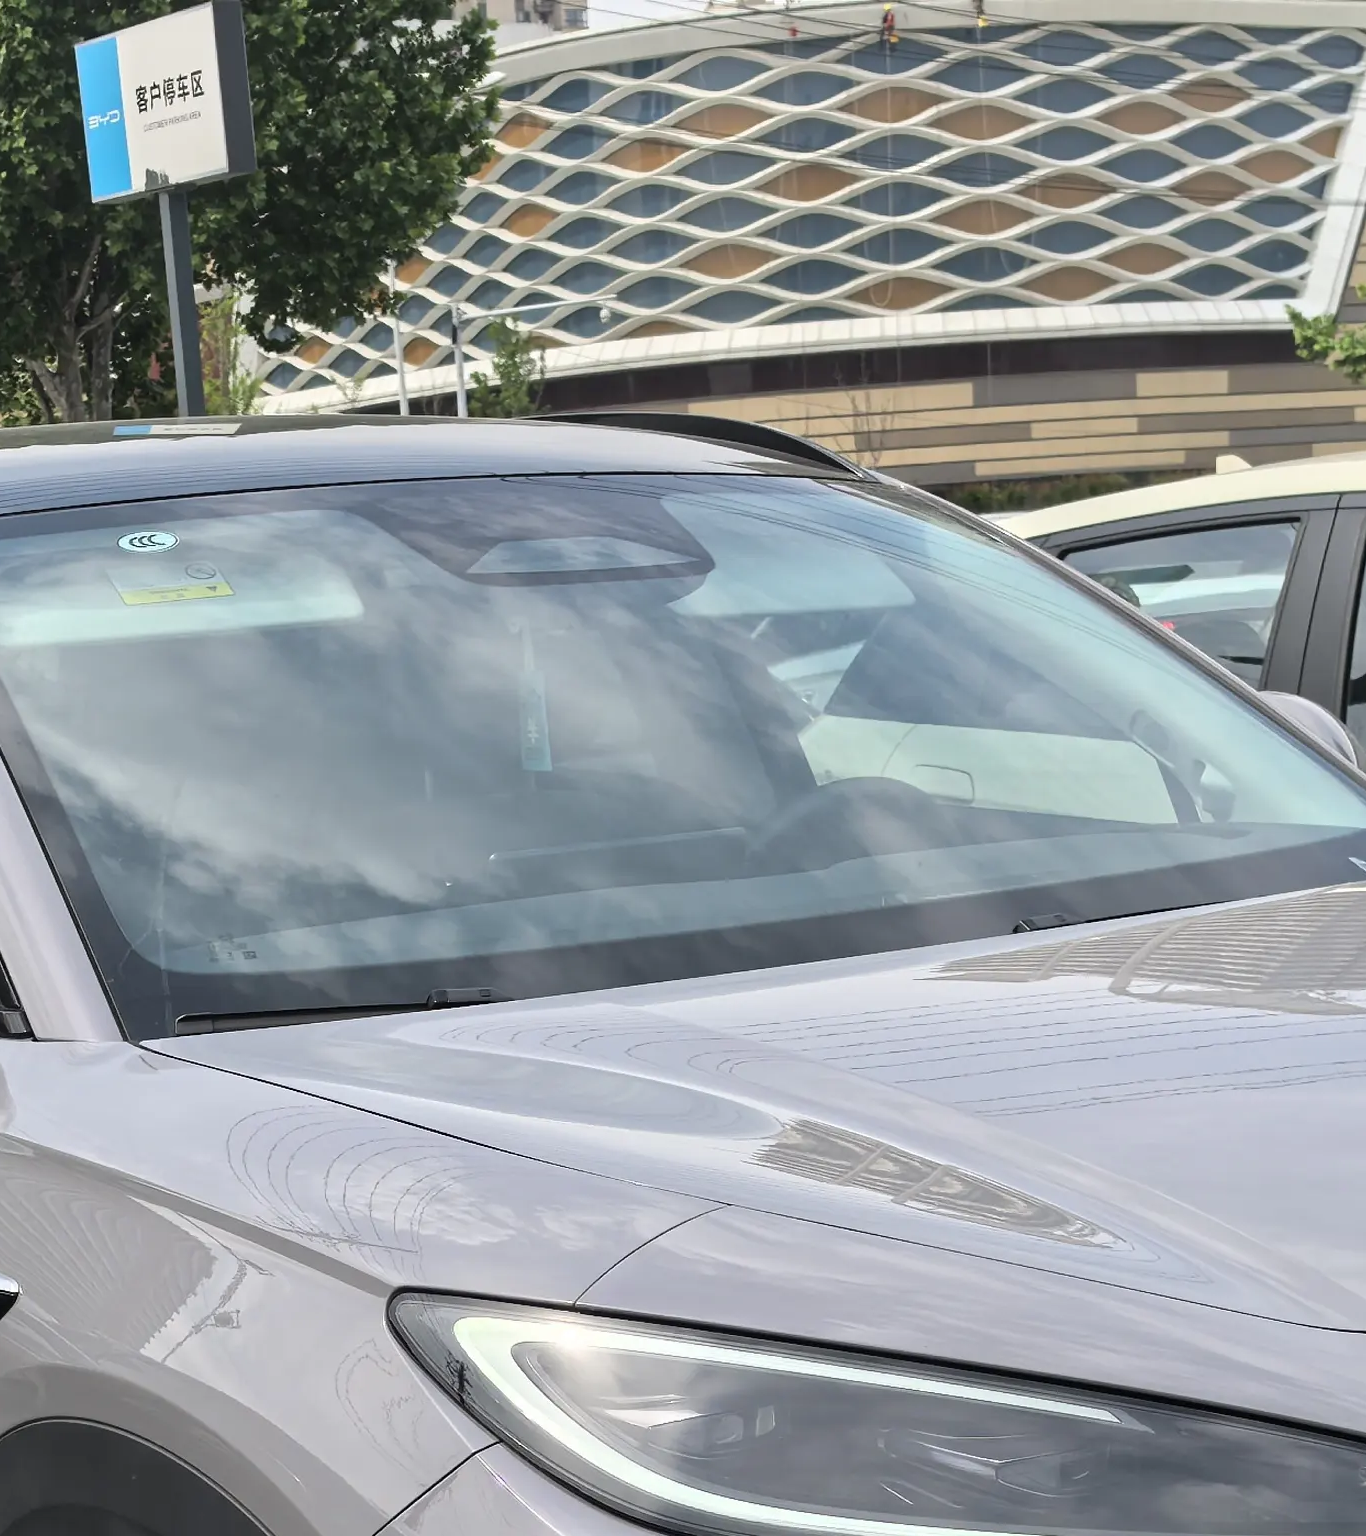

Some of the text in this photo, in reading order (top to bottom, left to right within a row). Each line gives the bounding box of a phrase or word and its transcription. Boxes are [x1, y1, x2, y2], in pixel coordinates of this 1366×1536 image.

[136, 69, 205, 114] 客户停车区
[87, 109, 120, 130] BYD
